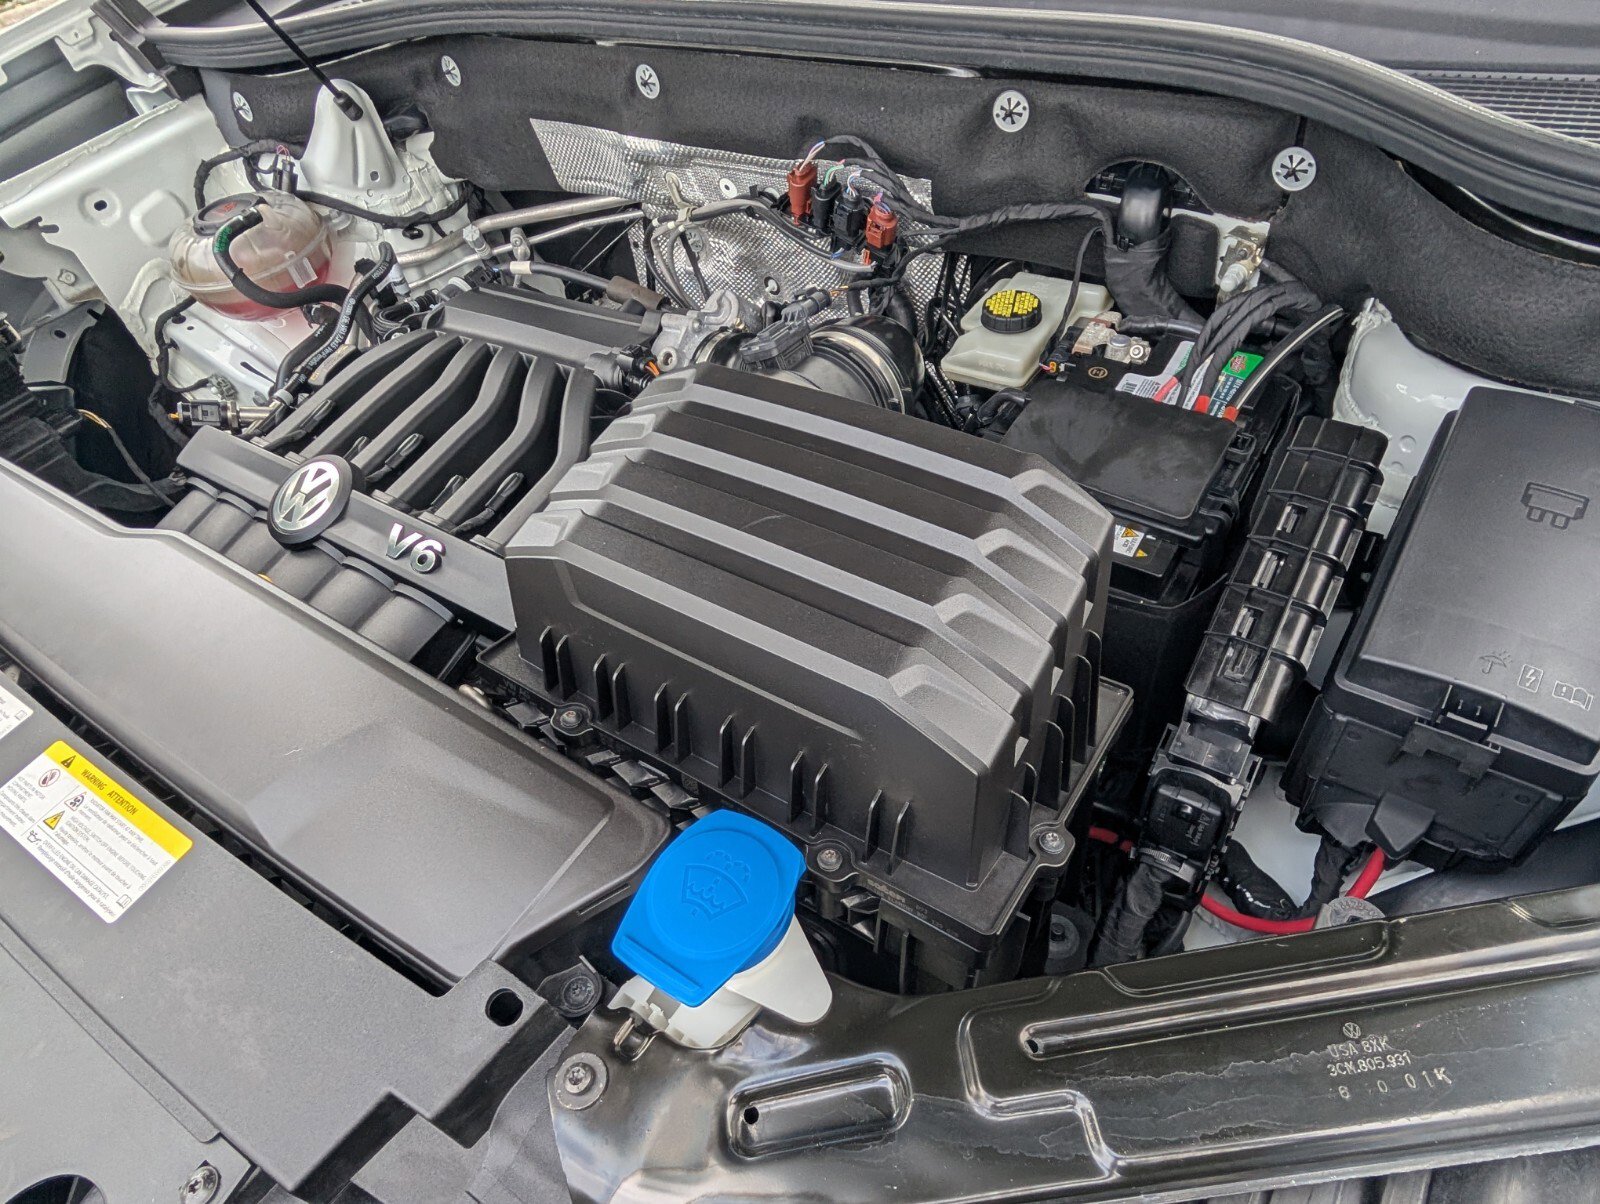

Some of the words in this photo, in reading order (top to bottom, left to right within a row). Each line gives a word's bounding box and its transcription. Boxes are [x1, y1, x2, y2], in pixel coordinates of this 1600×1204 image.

[386, 522, 445, 574] V6
[79, 768, 108, 790] WARNING
[106, 789, 139, 815] ATTENTION
[1327, 1040, 1359, 1059] USA
[1361, 1035, 1393, 1053] 8XK
